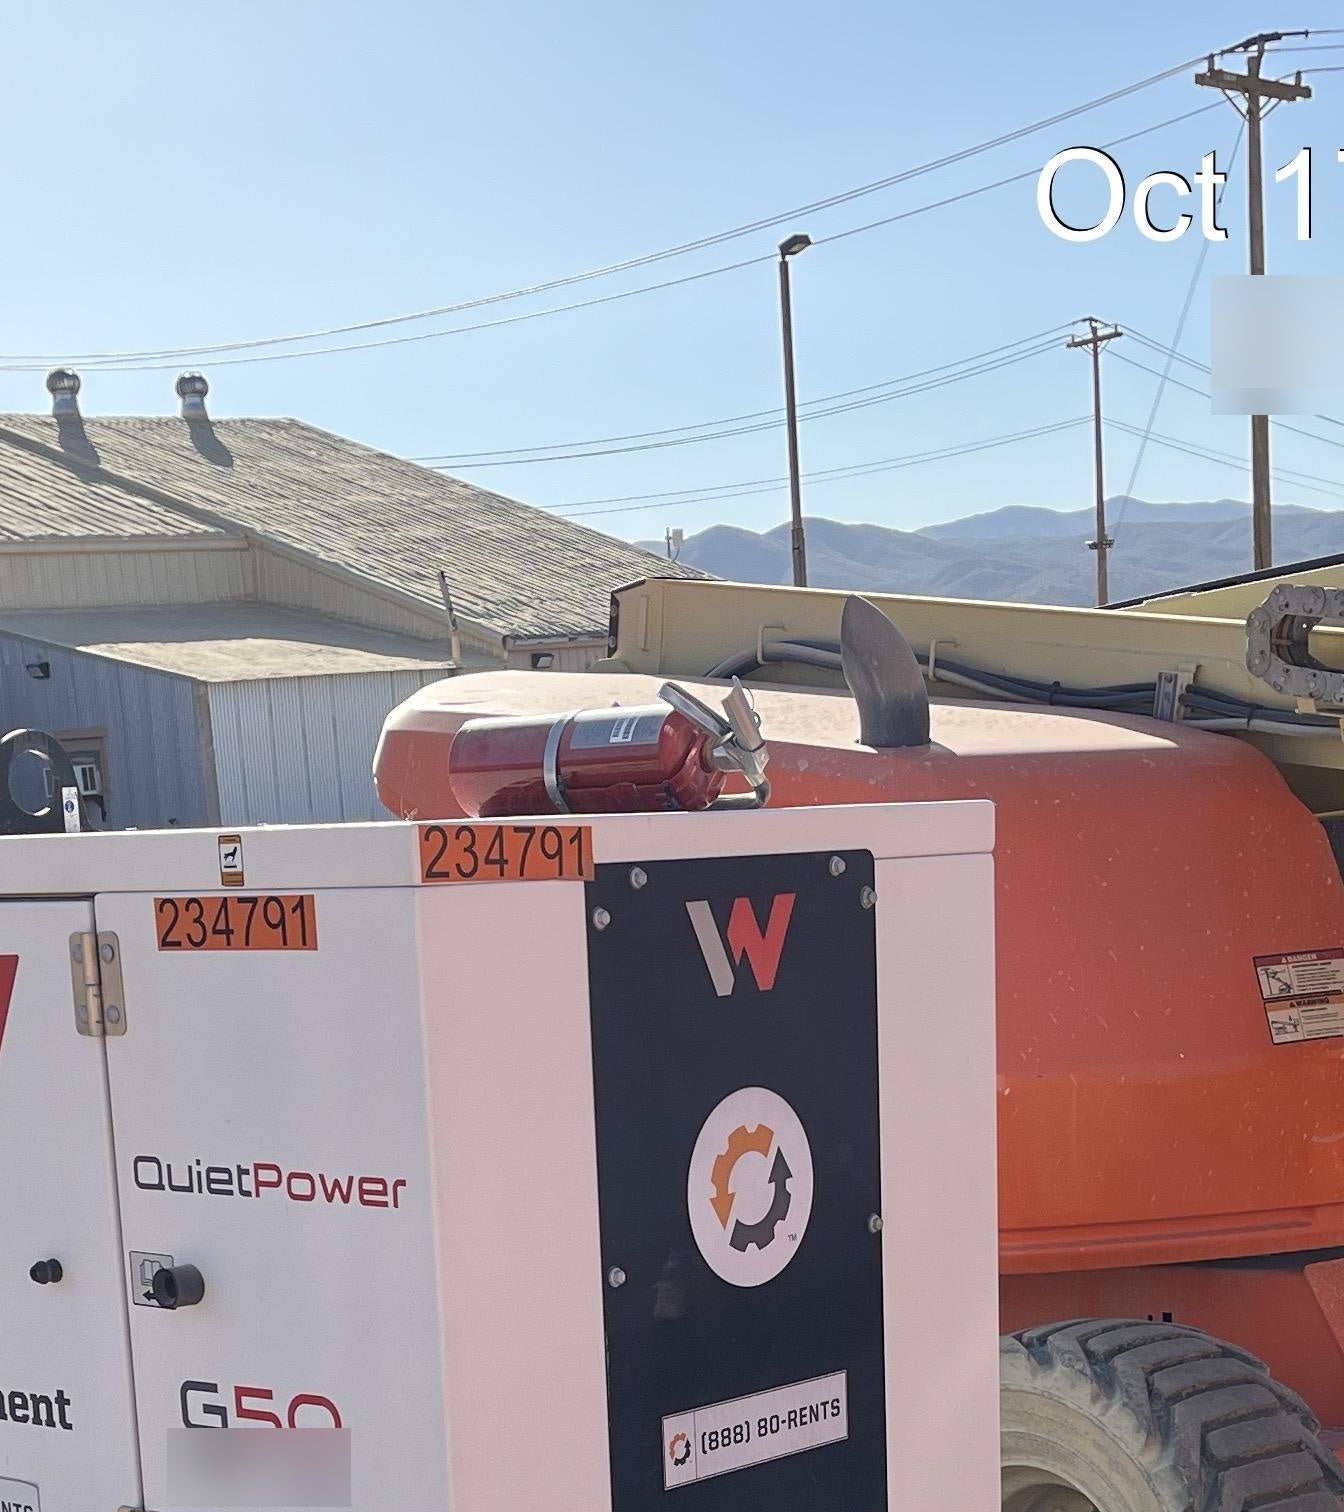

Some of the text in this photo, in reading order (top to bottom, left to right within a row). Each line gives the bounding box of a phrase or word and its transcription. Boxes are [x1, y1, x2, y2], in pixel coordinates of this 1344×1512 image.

[423, 825, 584, 879] 234791
[158, 896, 311, 947] 234791
[1287, 953, 1318, 962] DANGER
[1296, 996, 1330, 1008] WARNING
[133, 1155, 407, 1209] QuietPower
[701, 1398, 841, 1455] (888) 80-RENTS
